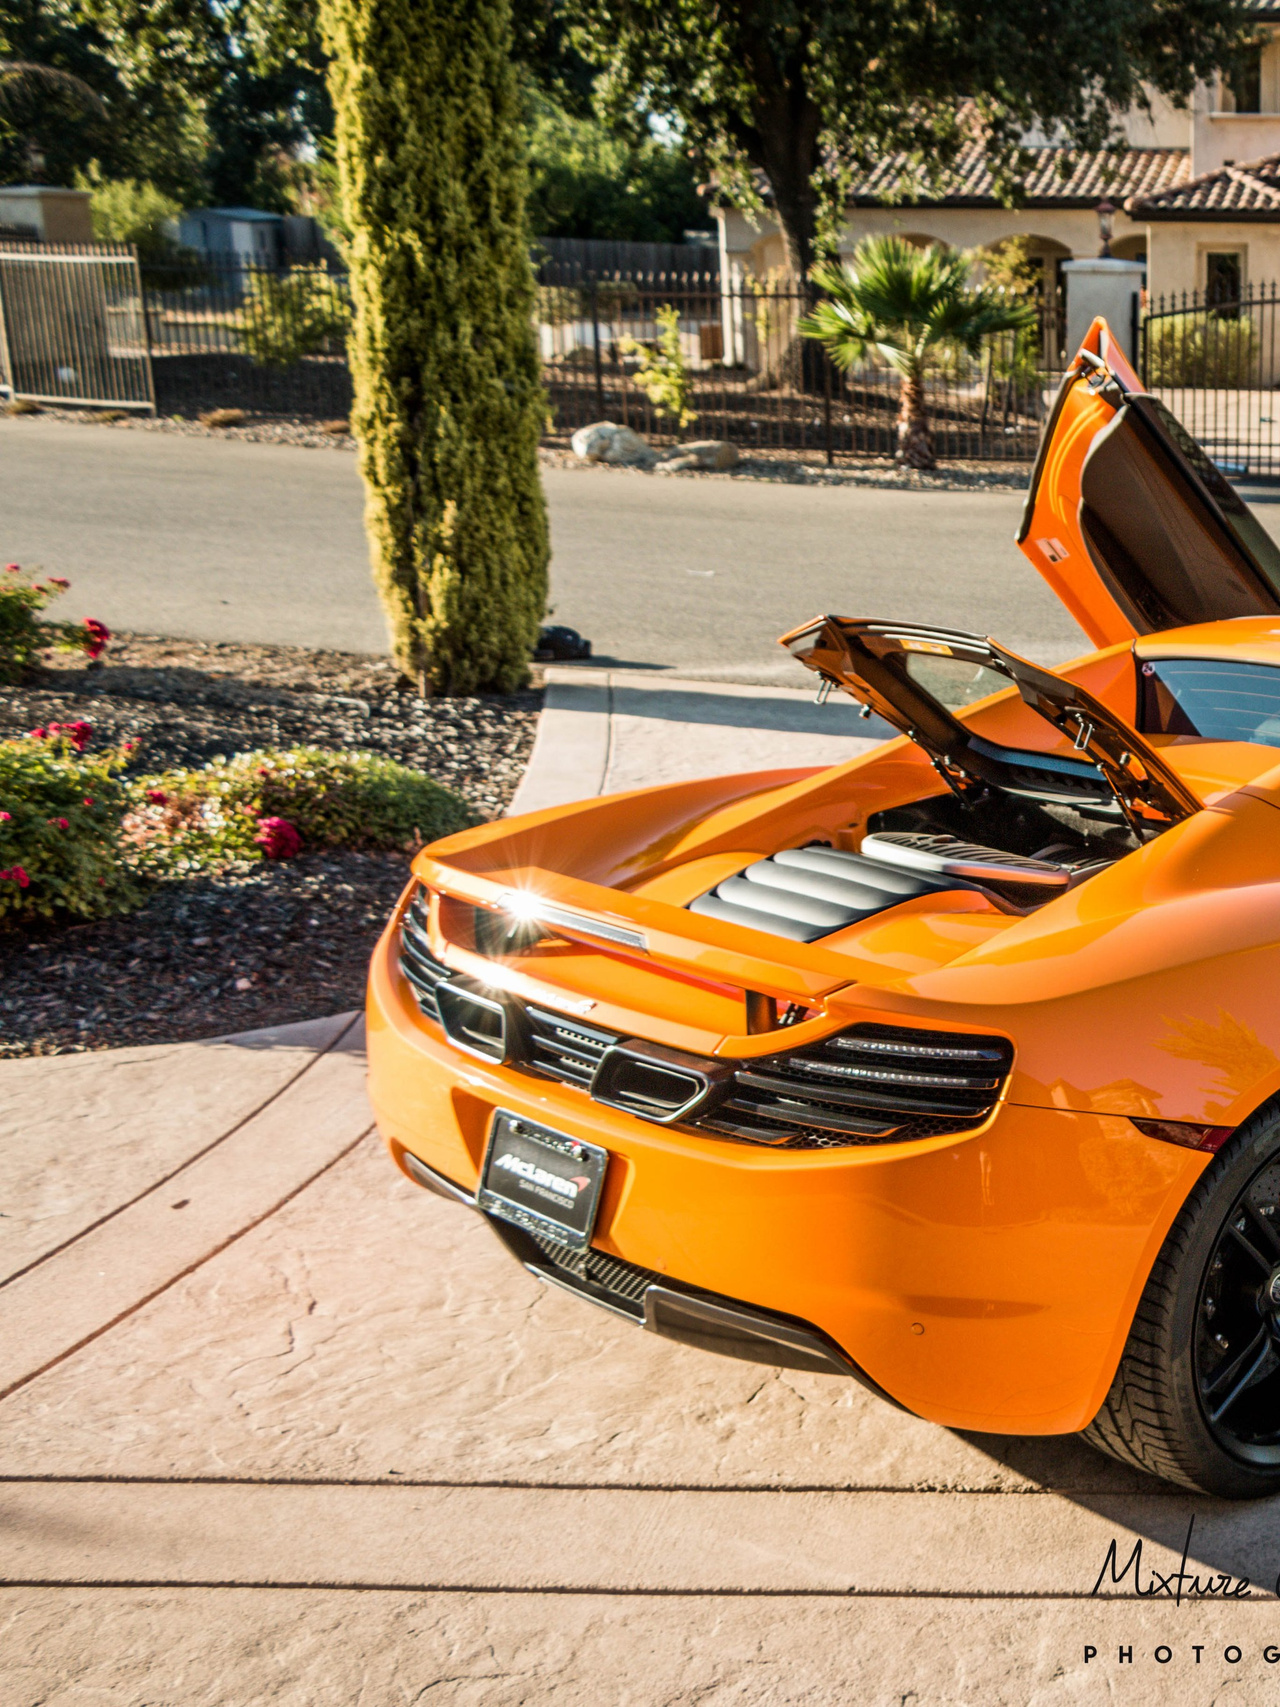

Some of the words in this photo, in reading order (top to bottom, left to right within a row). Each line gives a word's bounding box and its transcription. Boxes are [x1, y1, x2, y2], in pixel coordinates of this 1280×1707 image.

[494, 1153, 579, 1198] McLaren
[518, 1178, 535, 1192] SAN
[535, 1185, 575, 1210] FRANCISCO
